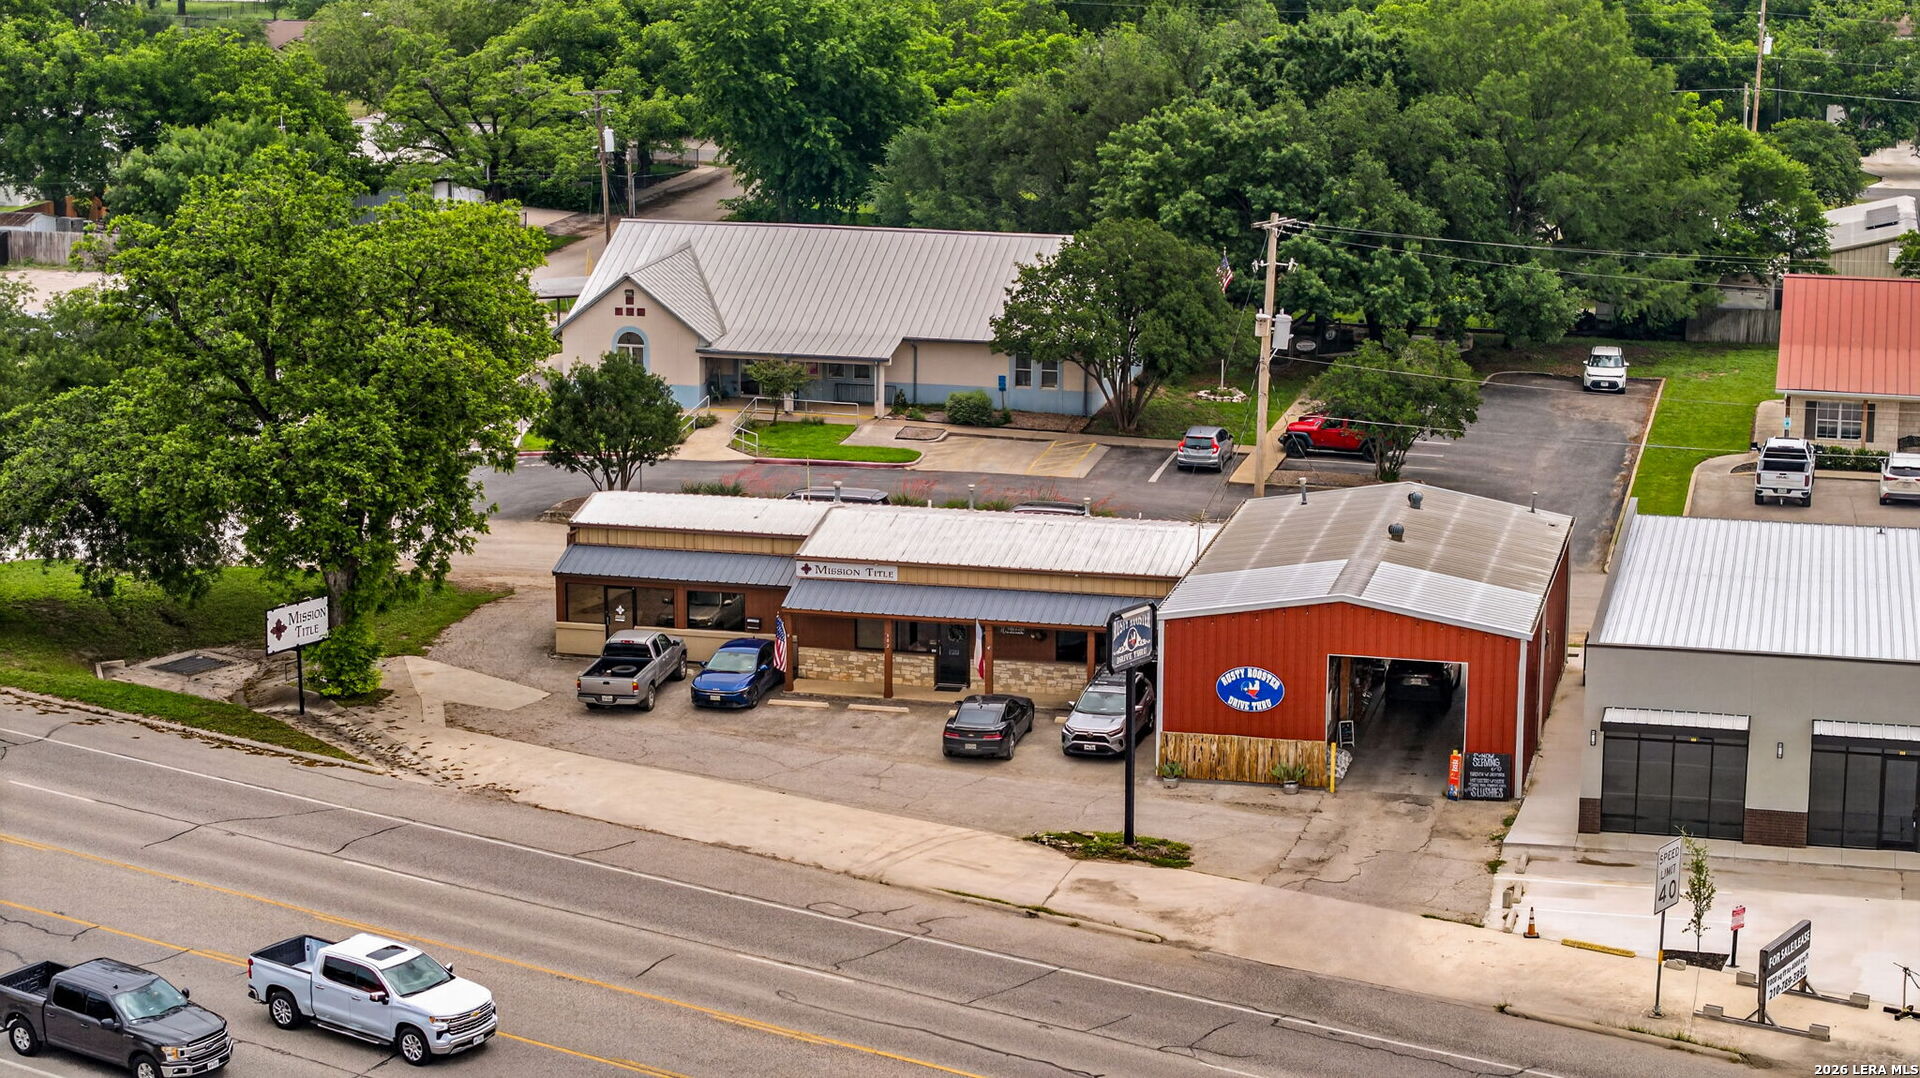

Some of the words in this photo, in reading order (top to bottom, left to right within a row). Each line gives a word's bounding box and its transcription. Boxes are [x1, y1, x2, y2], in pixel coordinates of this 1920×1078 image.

[815, 565, 861, 576] MISSION
[865, 568, 894, 578] TITLE
[288, 607, 326, 626] MISSION
[295, 624, 319, 638] TITLE
[1116, 652, 1132, 665] DRIVE
[1220, 668, 1244, 686] RUSTY
[1247, 668, 1281, 690] ROOSTER
[1227, 696, 1250, 711] DRIVE
[1251, 698, 1272, 711] THRU
[1470, 786, 1504, 799] SLUSHIES
[1660, 846, 1679, 865] SPEED
[1660, 863, 1677, 881] LIMIT
[1658, 879, 1677, 904] 40
[1768, 950, 1781, 969] FOR
